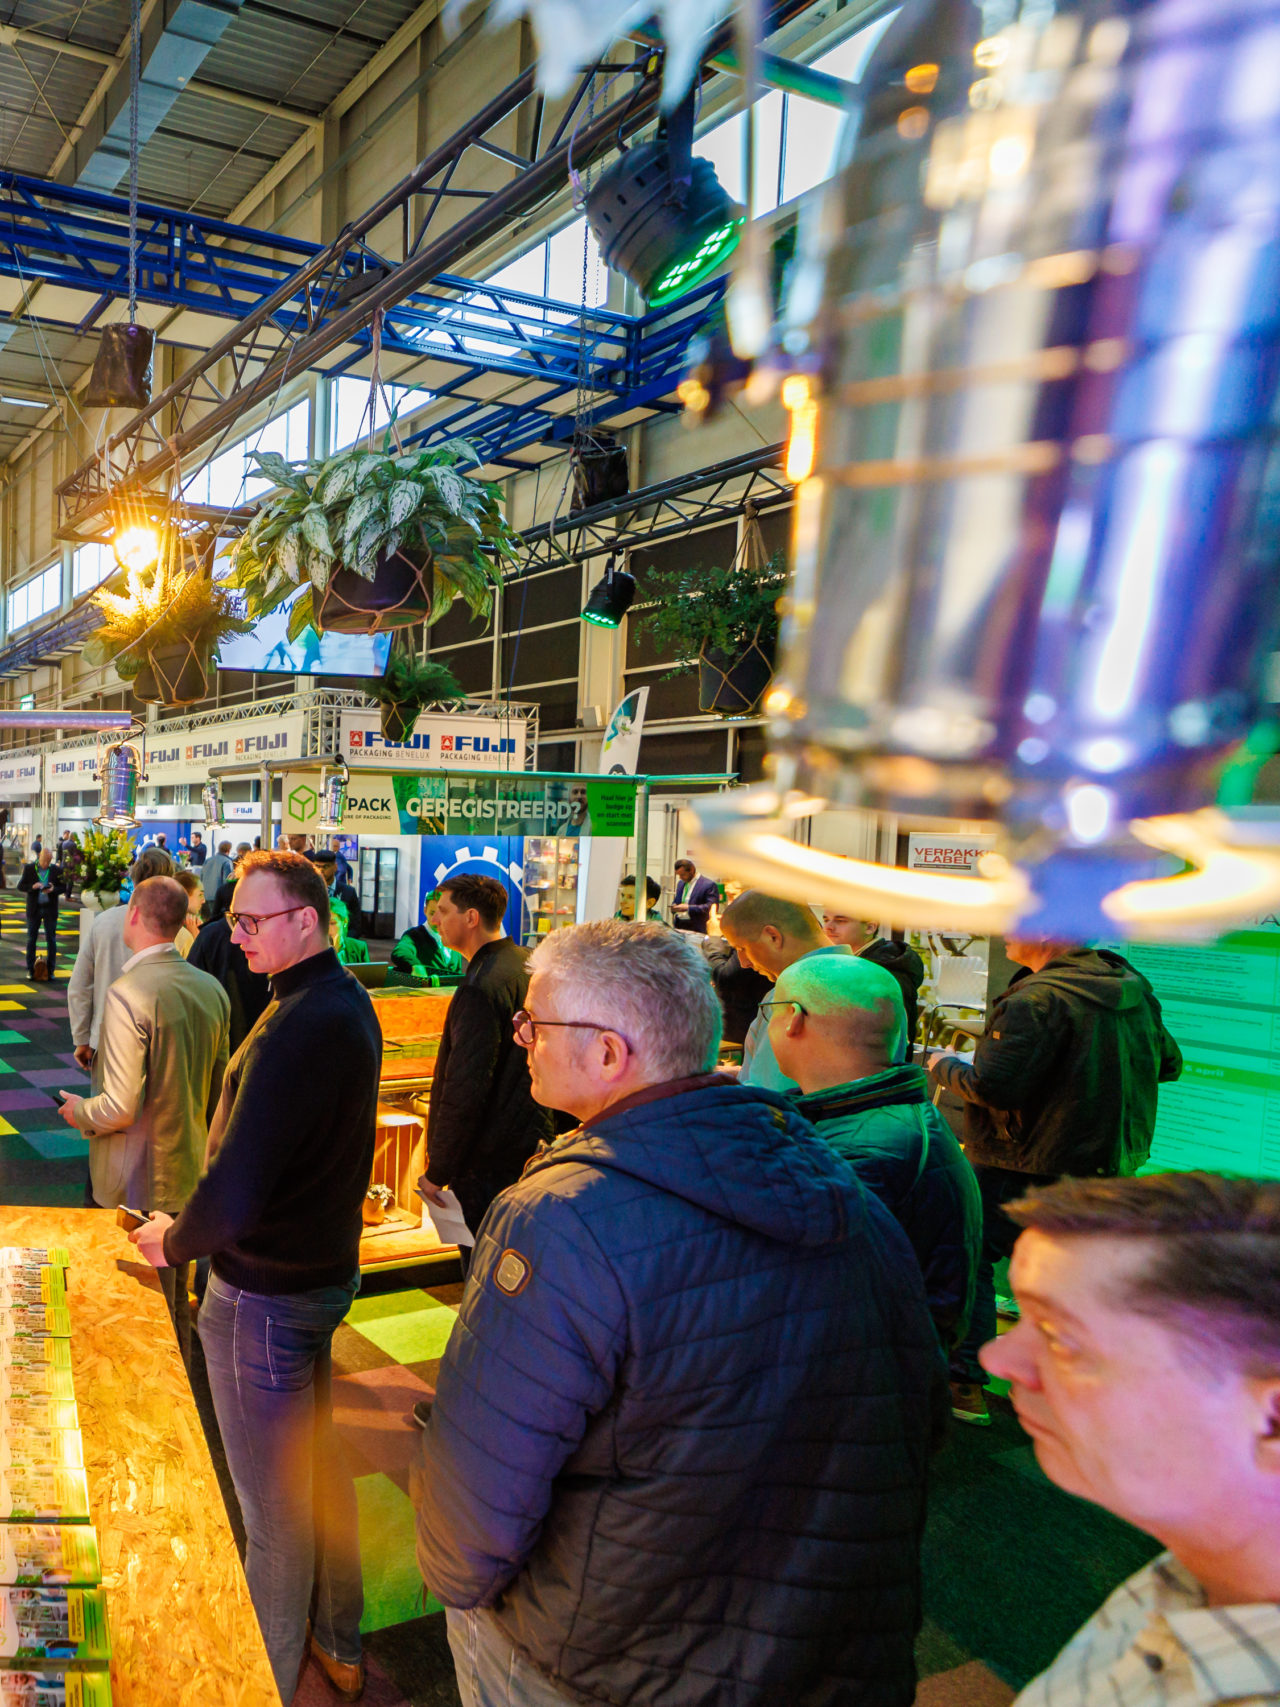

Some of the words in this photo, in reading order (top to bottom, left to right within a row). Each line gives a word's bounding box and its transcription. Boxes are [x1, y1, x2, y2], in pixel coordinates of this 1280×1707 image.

[244, 732, 288, 753] FUJI
[455, 736, 516, 753] FUJI
[150, 748, 180, 764] FUJI
[193, 741, 229, 759] FUJI
[349, 749, 393, 758] PACKAGING
[395, 751, 430, 759] BENELUX
[440, 753, 482, 761] PACKAGING
[20, 767, 36, 778] FUJI
[55, 761, 75, 774] FUJI
[344, 797, 392, 812] PACK
[405, 798, 582, 820] GEREGISTREERD?
[914, 847, 990, 858] VERPAKK
[923, 855, 972, 865] LABEL
